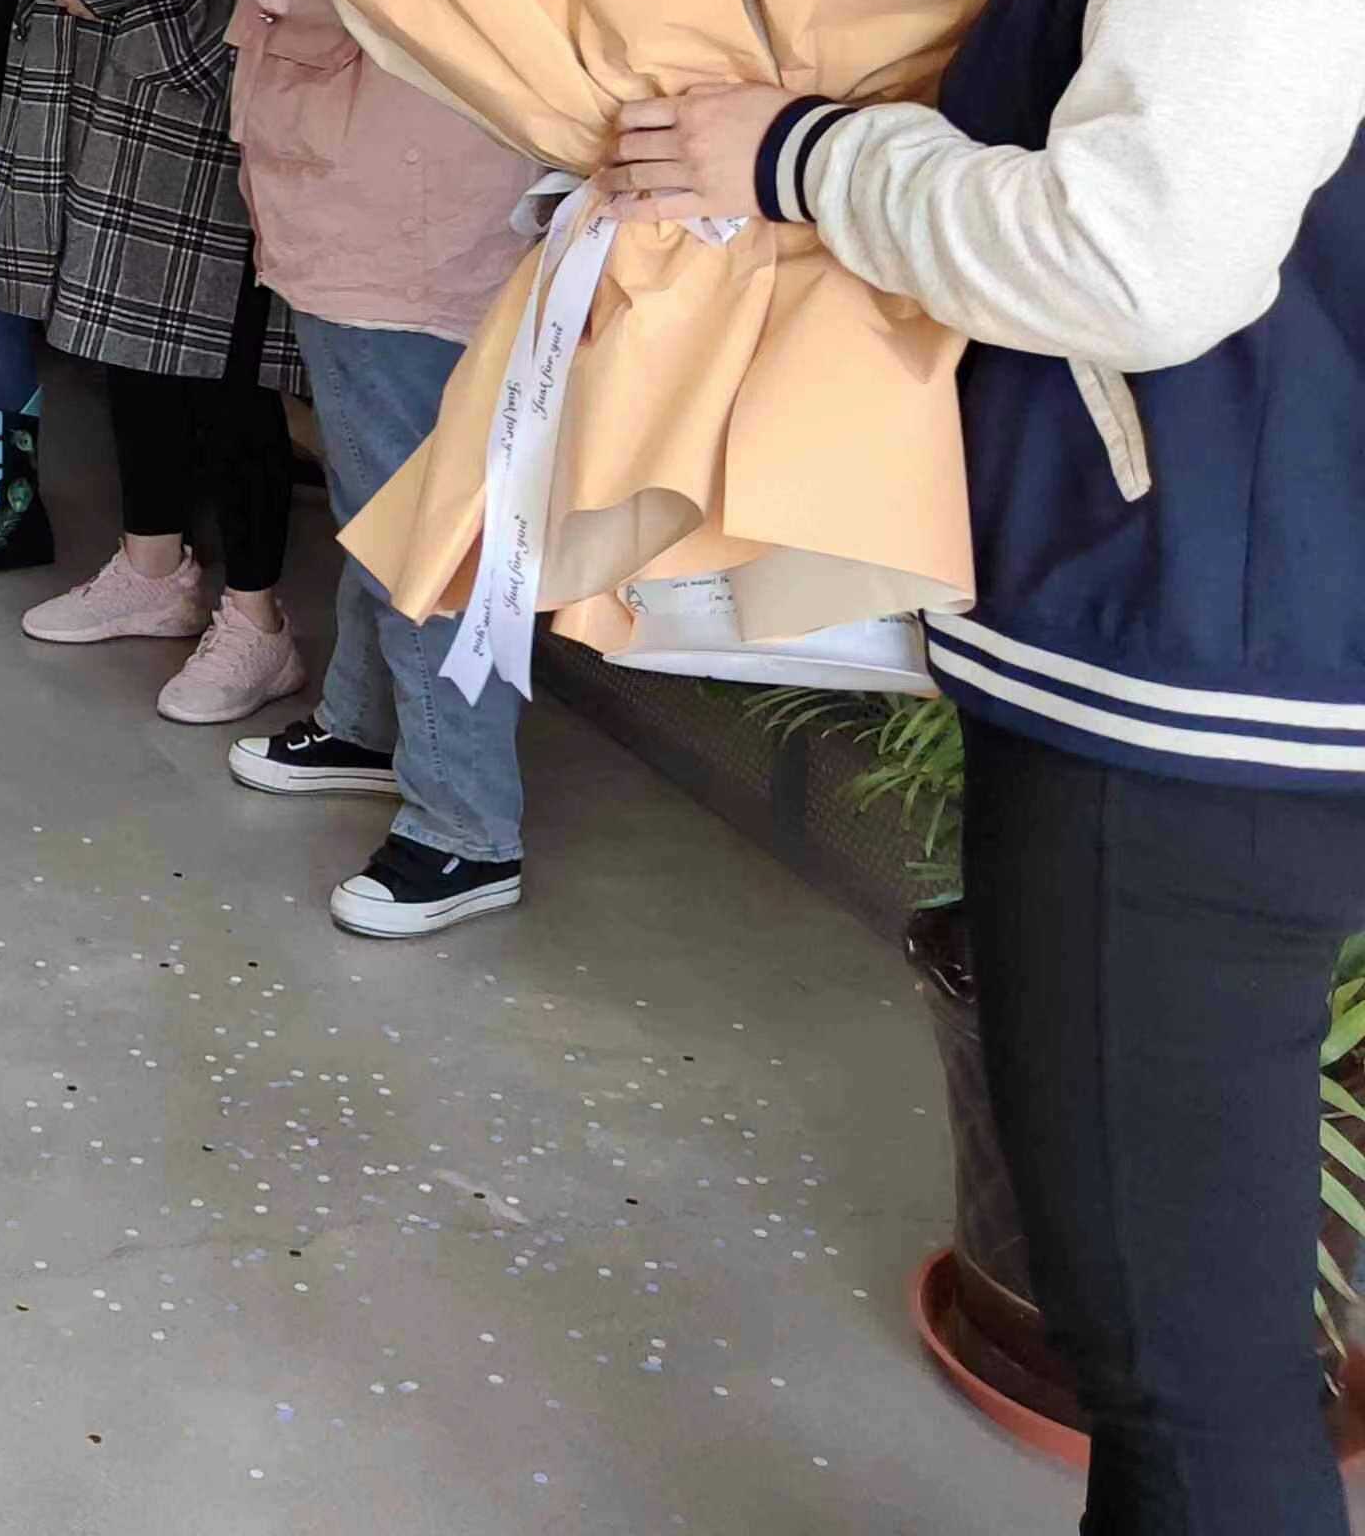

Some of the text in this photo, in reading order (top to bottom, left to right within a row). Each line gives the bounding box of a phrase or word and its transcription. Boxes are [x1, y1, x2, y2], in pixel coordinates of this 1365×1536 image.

[531, 323, 564, 421] Just for you
[502, 519, 530, 615] Just for you
